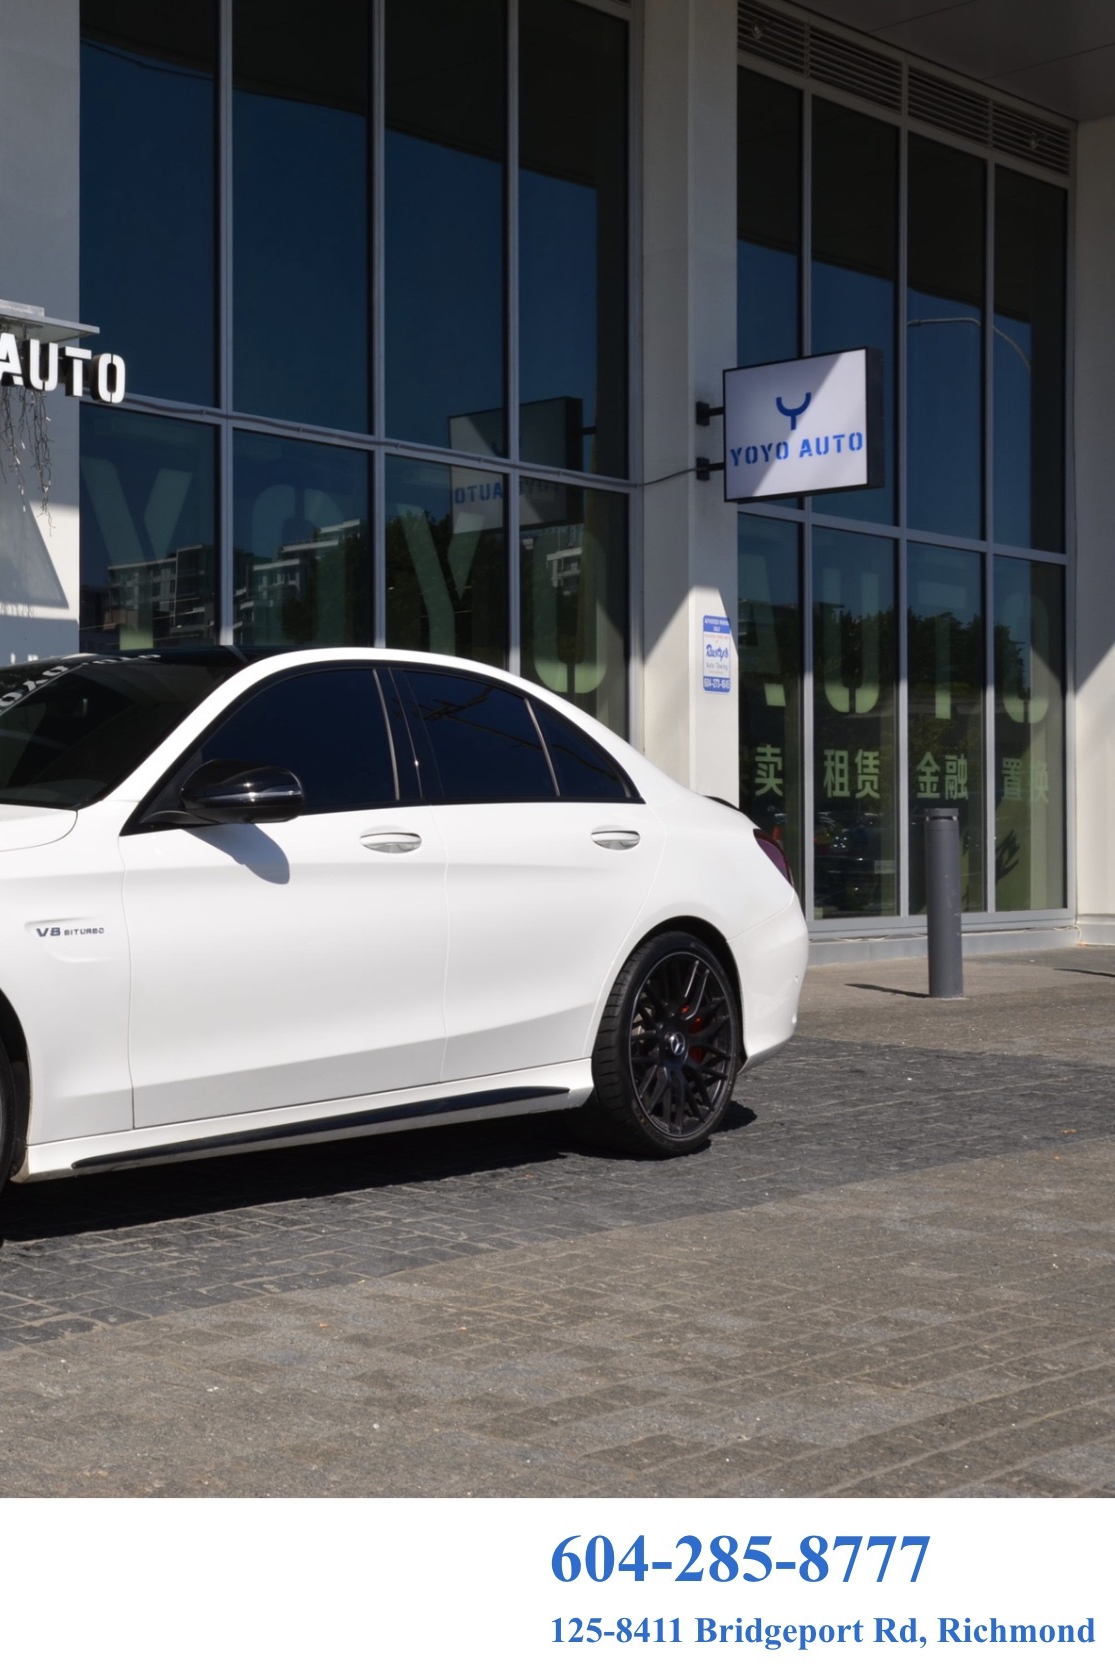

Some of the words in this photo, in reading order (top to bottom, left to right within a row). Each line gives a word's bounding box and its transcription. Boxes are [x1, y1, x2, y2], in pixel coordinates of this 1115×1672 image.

[730, 441, 790, 467] YOYO
[798, 431, 864, 458] AUTO
[741, 744, 784, 798] 卖
[823, 748, 881, 799] 租赁
[916, 751, 969, 801] 金融
[36, 927, 61, 937] V8
[64, 927, 105, 936] BITURBO
